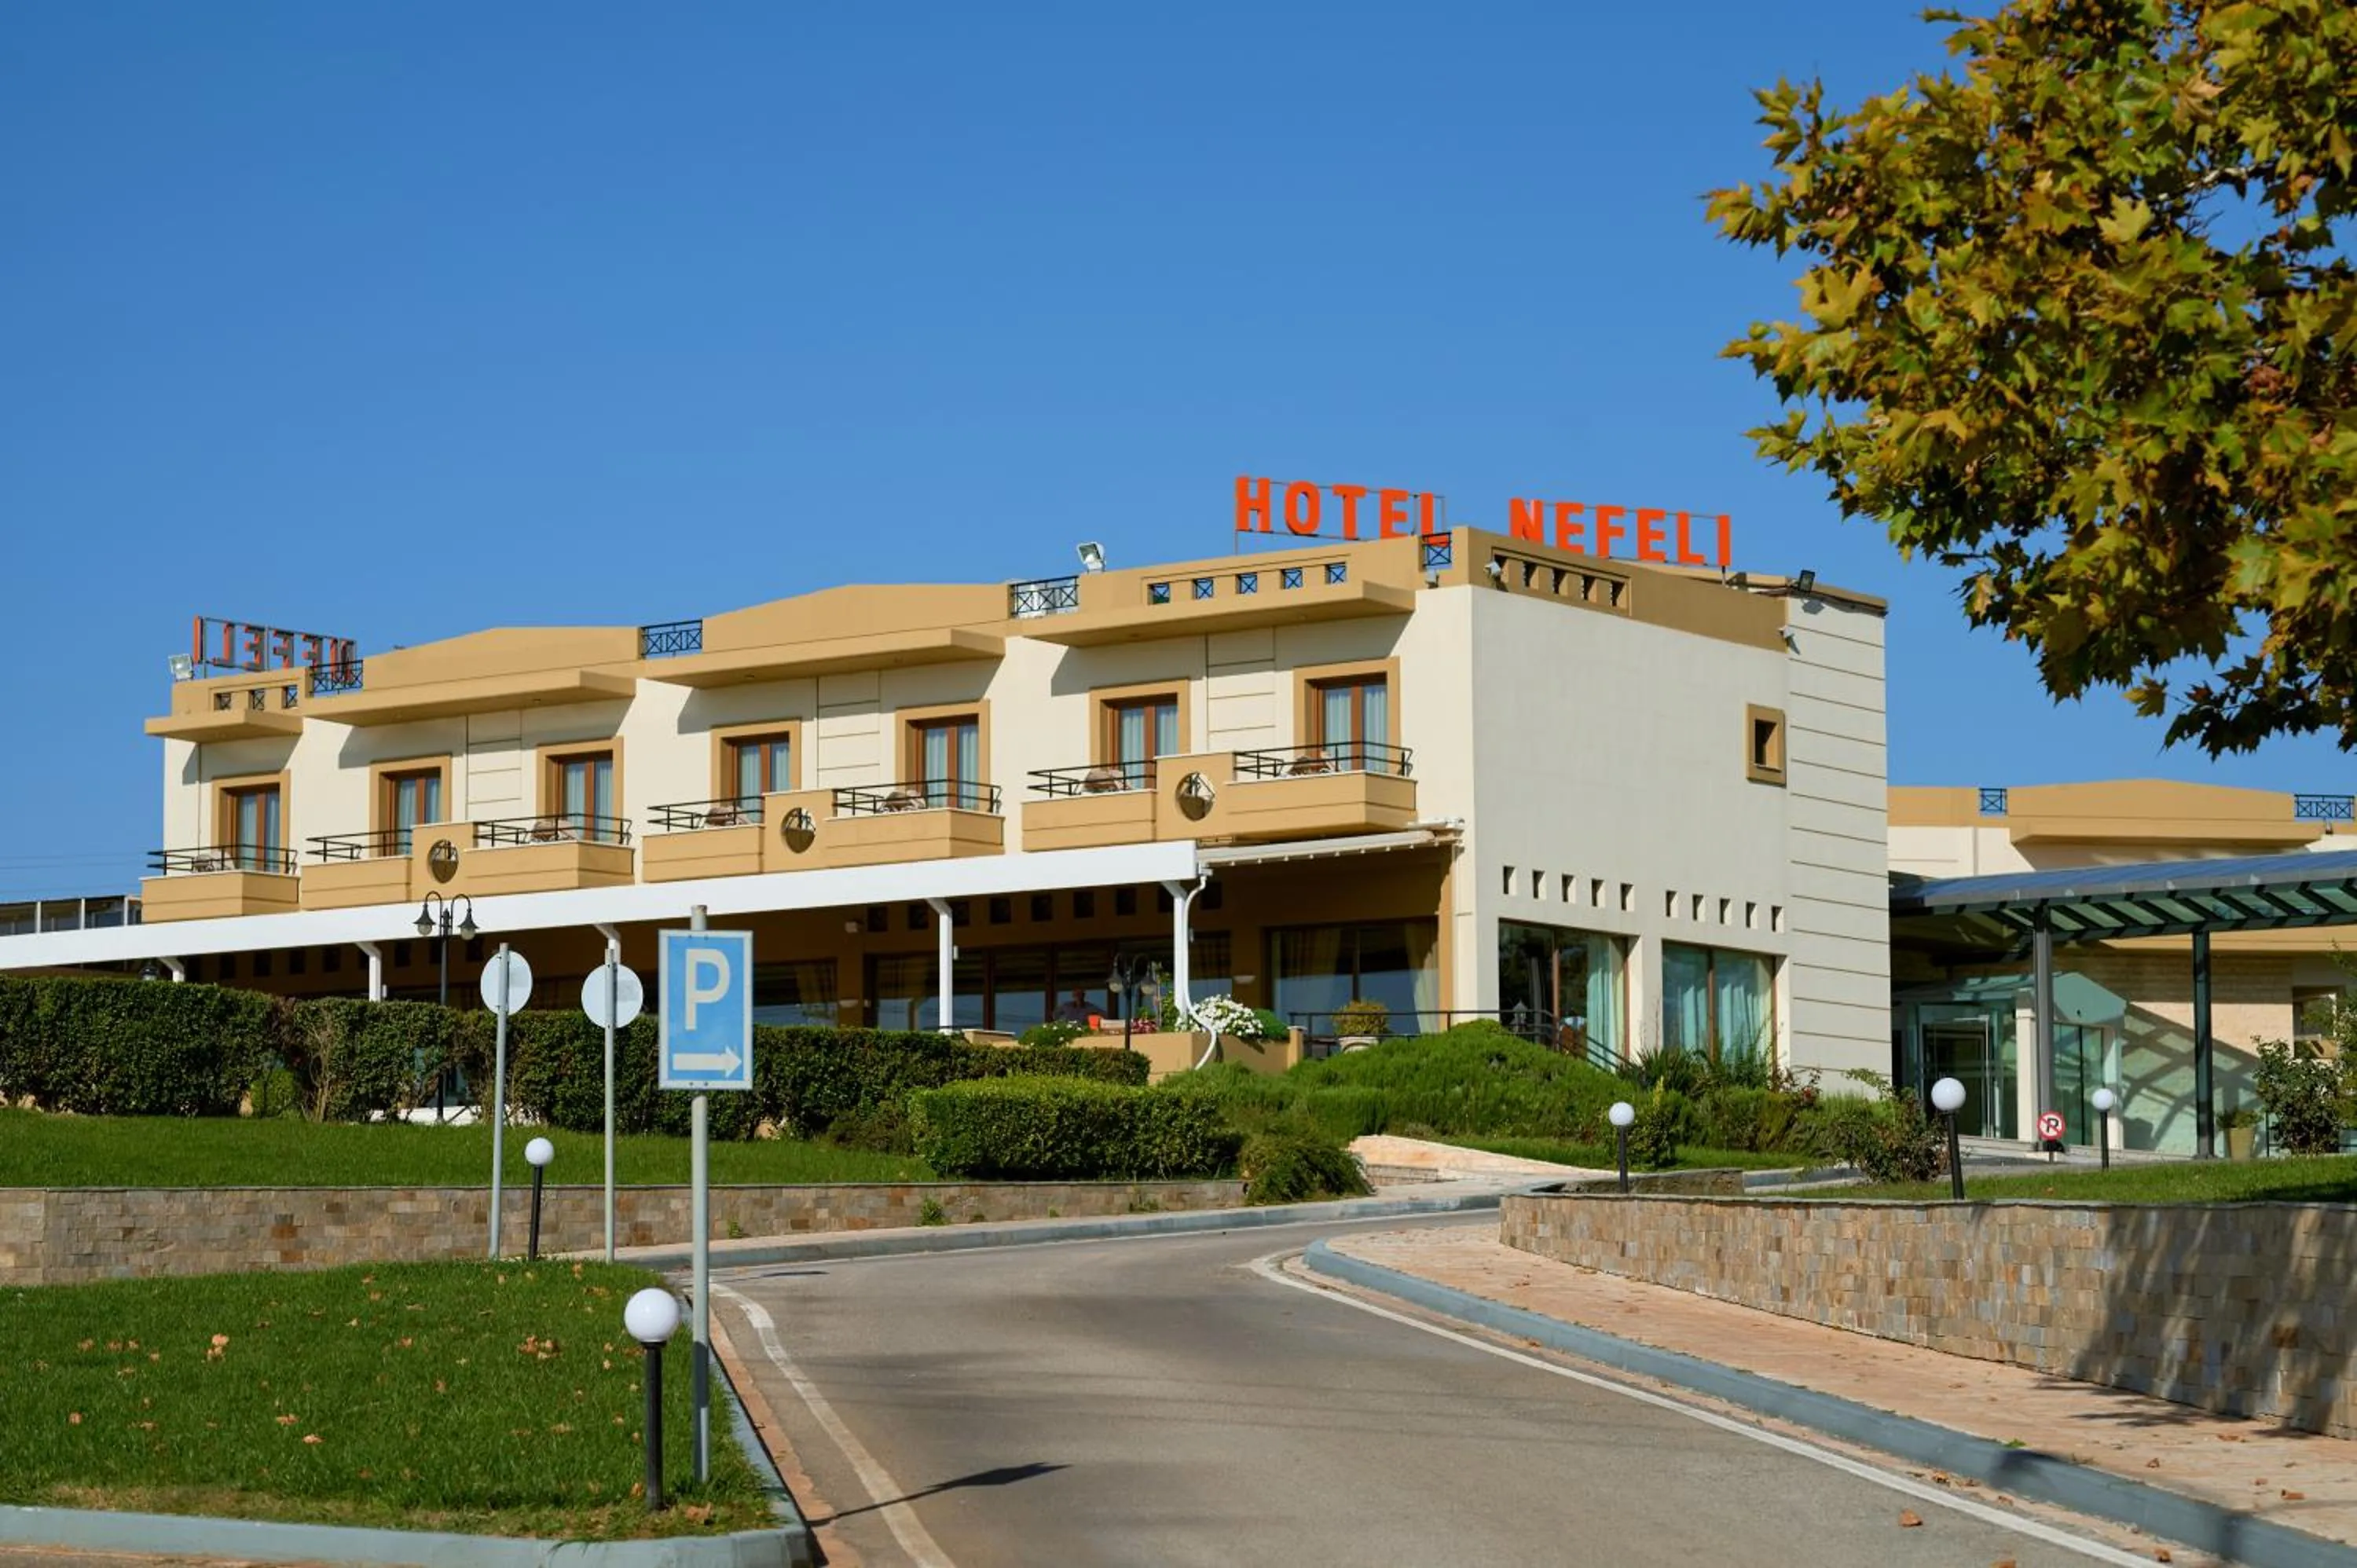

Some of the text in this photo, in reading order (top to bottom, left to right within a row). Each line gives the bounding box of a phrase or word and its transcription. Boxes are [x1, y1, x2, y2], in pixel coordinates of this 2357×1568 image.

[1235, 476, 1731, 566] HOTEL NEFELI
[685, 948, 731, 1031] P
